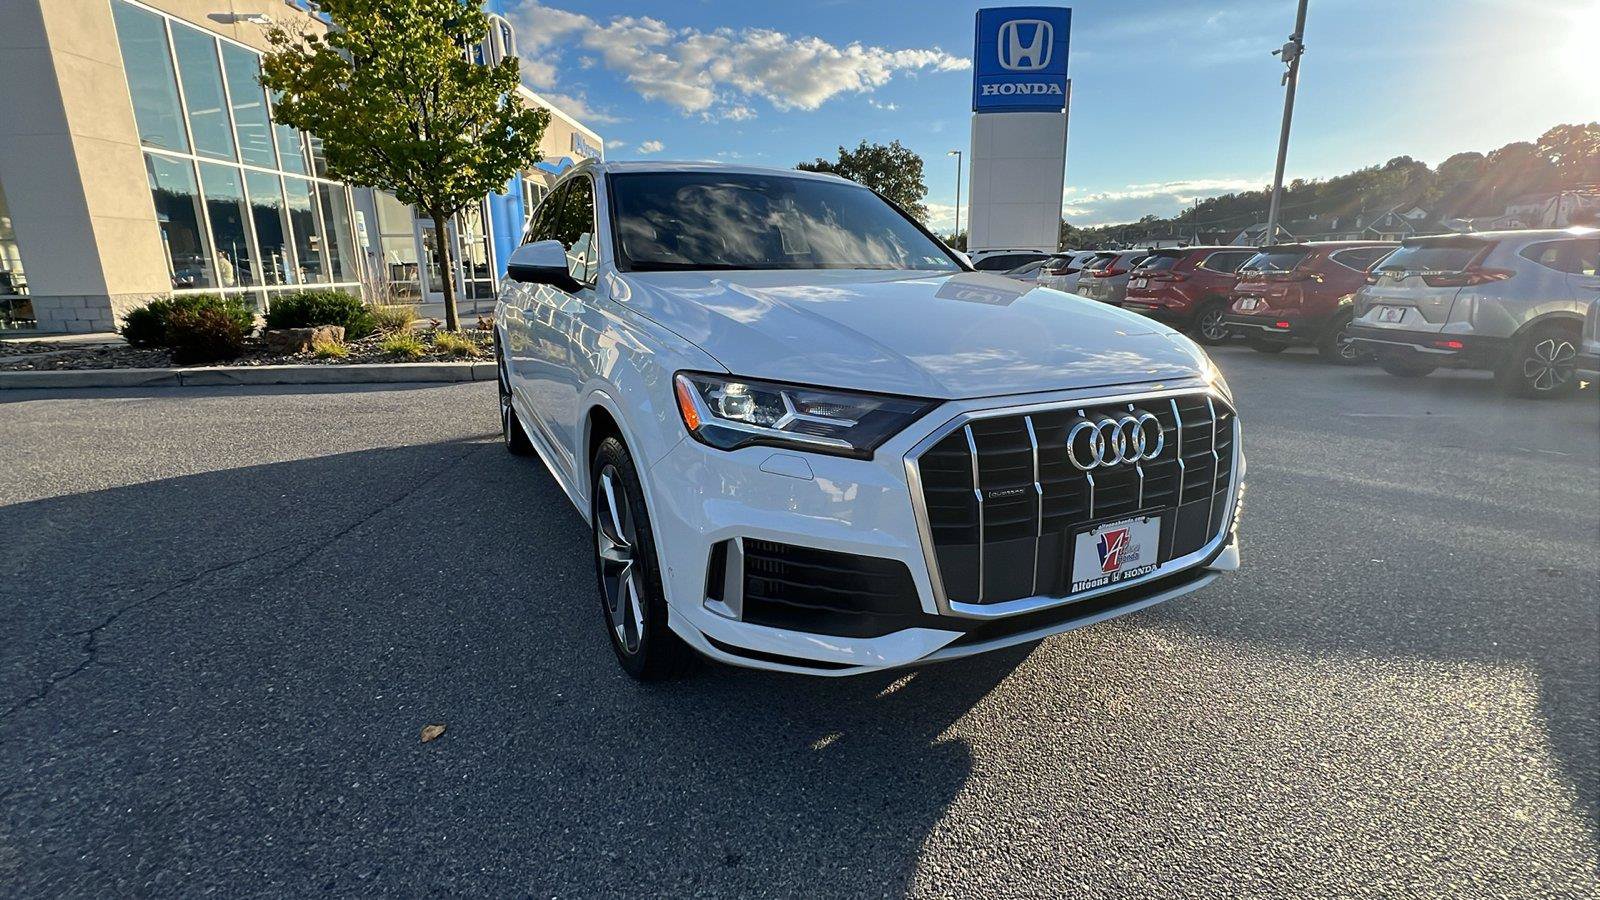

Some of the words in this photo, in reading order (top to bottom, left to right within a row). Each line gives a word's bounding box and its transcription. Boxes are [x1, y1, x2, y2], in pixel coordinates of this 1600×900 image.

[981, 83, 1063, 96] HONDA
[1071, 577, 1109, 593] Altoona
[1123, 564, 1158, 579] HONDA
